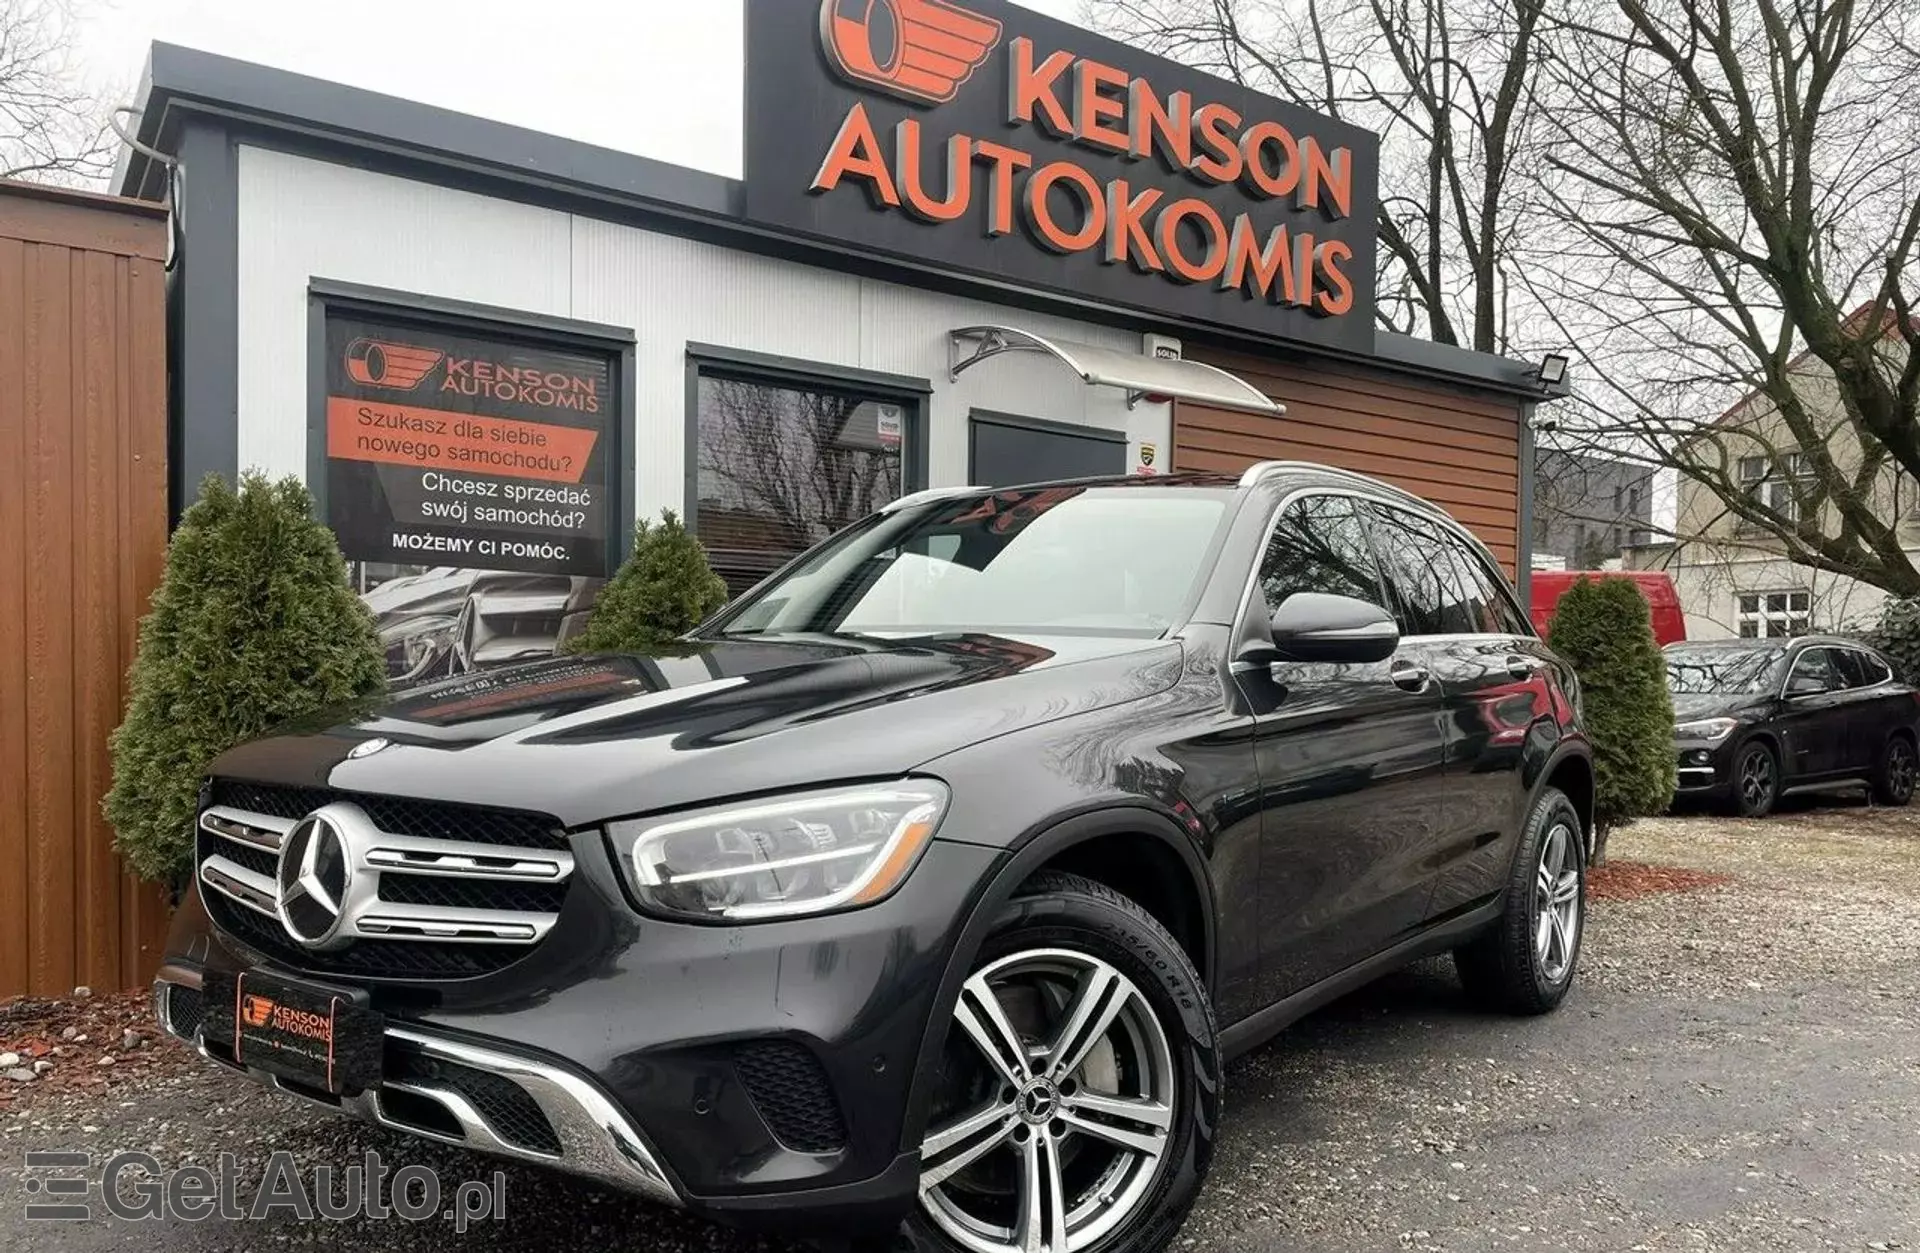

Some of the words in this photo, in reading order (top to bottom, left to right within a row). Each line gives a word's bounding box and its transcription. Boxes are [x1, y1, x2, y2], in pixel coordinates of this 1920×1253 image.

[1008, 36, 1352, 220] KENSON
[809, 101, 1354, 318] AUTOKOMIS
[440, 376, 599, 413] AUTOKOMIS
[446, 357, 596, 395] KENSON
[357, 407, 447, 435] Szukasz
[454, 420, 483, 440] dla
[490, 426, 547, 447] siebie
[357, 435, 440, 459] nowego
[448, 444, 572, 473] samochodu?
[421, 472, 498, 497] Chcesz
[504, 483, 591, 506] sprzedać
[421, 501, 468, 523] swój
[474, 505, 585, 528] samochód?
[392, 532, 473, 555] MOŻEMY
[478, 540, 497, 555] CI
[501, 541, 571, 560] POMÓC.
[271, 1018, 332, 1042] AUTOKOMIS
[273, 1005, 331, 1028] KENSON
